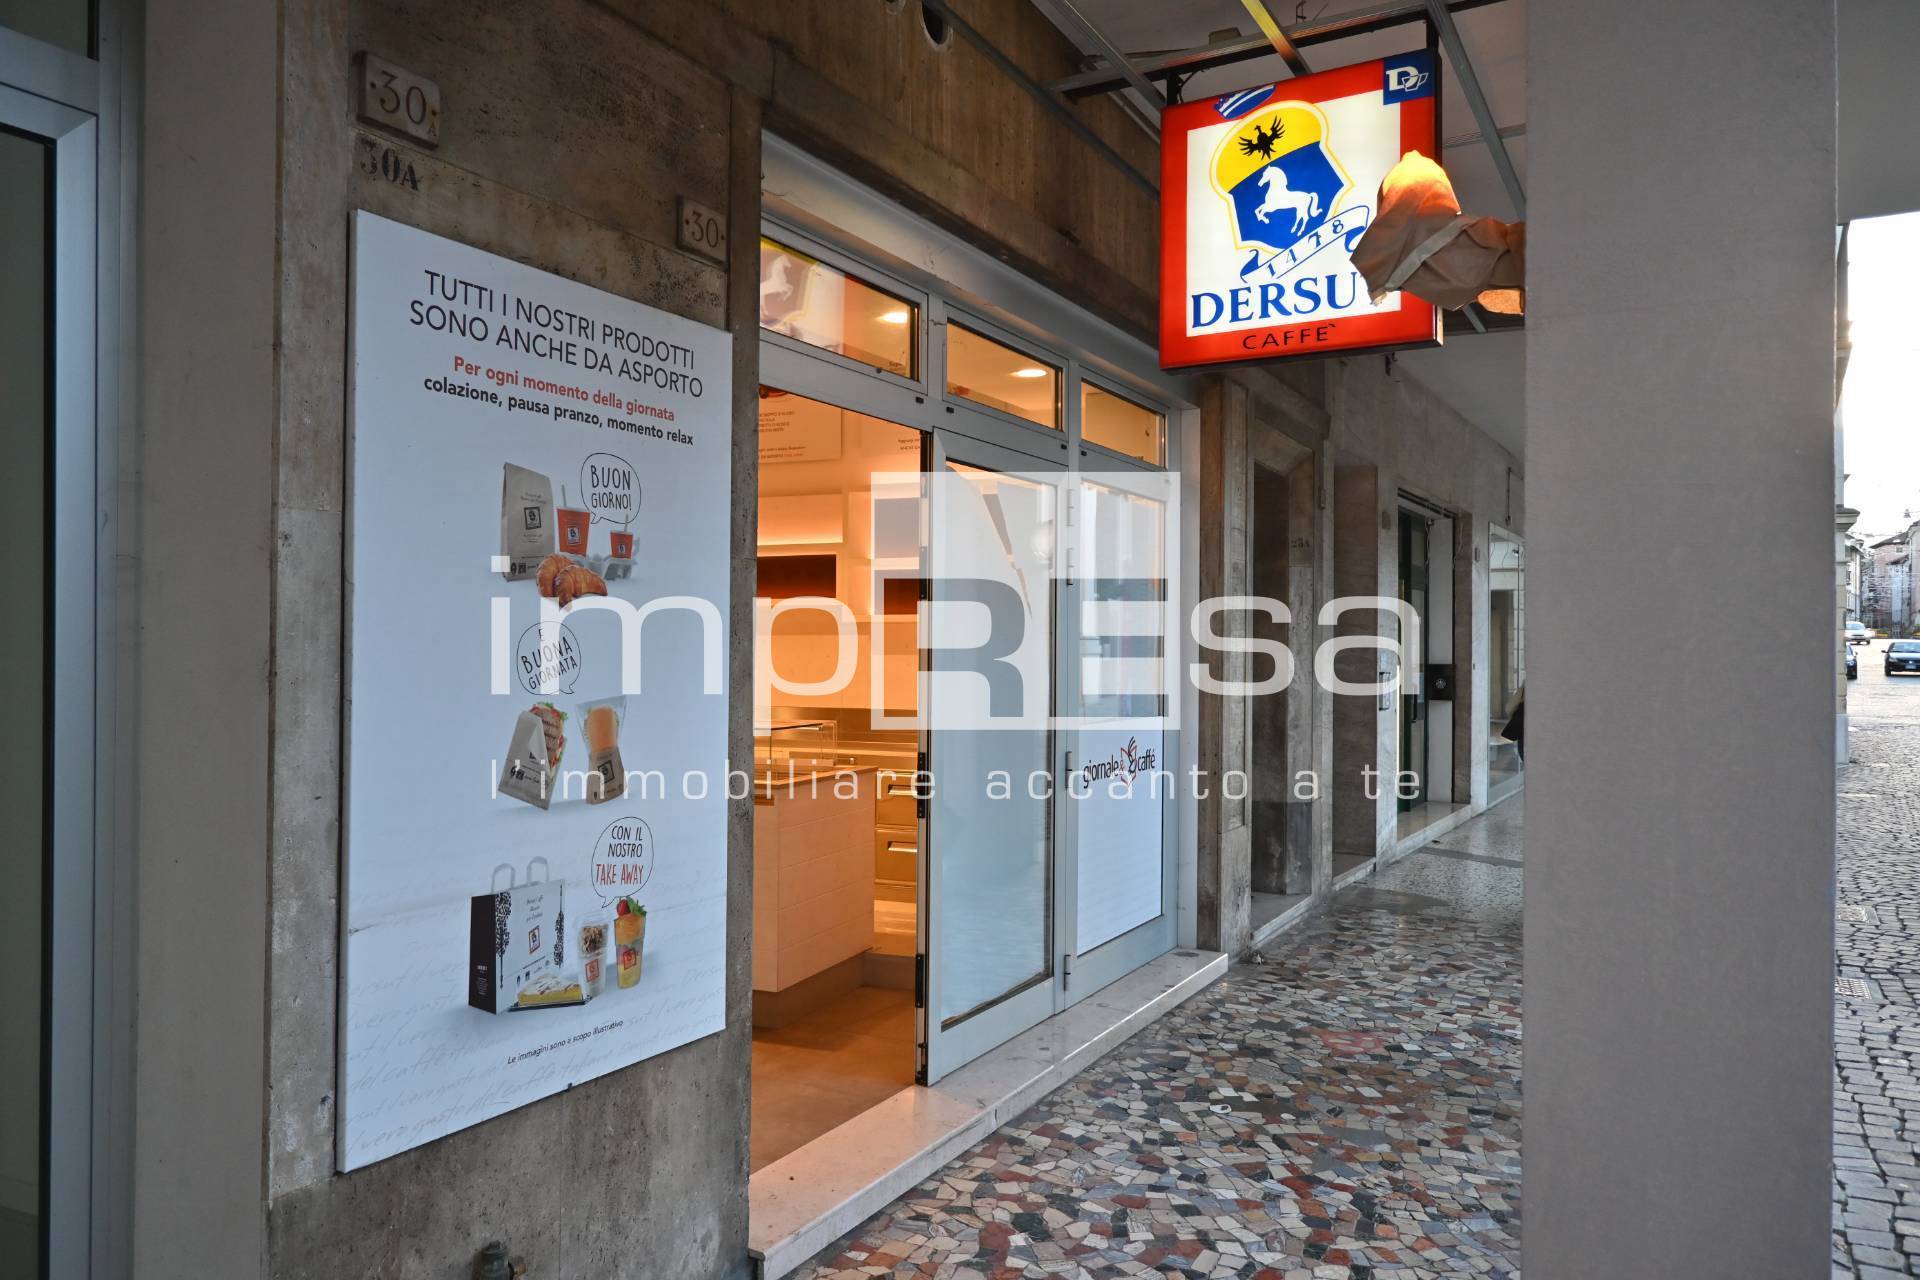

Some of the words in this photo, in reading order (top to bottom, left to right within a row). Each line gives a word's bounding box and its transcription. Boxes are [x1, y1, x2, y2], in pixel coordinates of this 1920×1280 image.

[380, 70, 427, 125] 30
[360, 137, 419, 191] 30A
[690, 211, 719, 248] 30
[1267, 219, 1344, 277] 1478
[424, 269, 494, 313] TUTTI
[502, 293, 508, 316] I
[516, 297, 596, 341] NOSTRI
[602, 324, 695, 370] PRODOTTI
[1191, 271, 1362, 328] DERSU
[409, 299, 489, 342] SONO
[495, 324, 577, 366] ANCHE
[583, 347, 613, 376] DA
[618, 357, 704, 398] ASPORTO
[453, 355, 481, 376] Per
[486, 363, 519, 387] ogni
[523, 375, 589, 402] momento
[593, 389, 623, 410] della
[626, 393, 675, 422] giornata
[423, 376, 503, 408] colazione,
[508, 394, 550, 416] pausa
[554, 404, 603, 429] pranzo,
[607, 416, 664, 439] momento
[667, 427, 694, 446] relax
[590, 464, 632, 491] BUON
[591, 493, 632, 511] GIORNO!
[521, 636, 573, 675] BUONA
[528, 655, 578, 691] GIORNATA
[1083, 753, 1119, 789] giornale
[607, 842, 644, 859] NOSTRO
[611, 825, 632, 842] CON
[634, 826, 644, 842] IL
[596, 863, 617, 886] TAKE
[620, 863, 645, 886] AWAY
[507, 1055, 517, 1065] Le
[518, 1044, 549, 1061] immagini
[550, 1039, 566, 1051] sono
[572, 1030, 592, 1044] scopo
[593, 1018, 624, 1036] illustrativo
